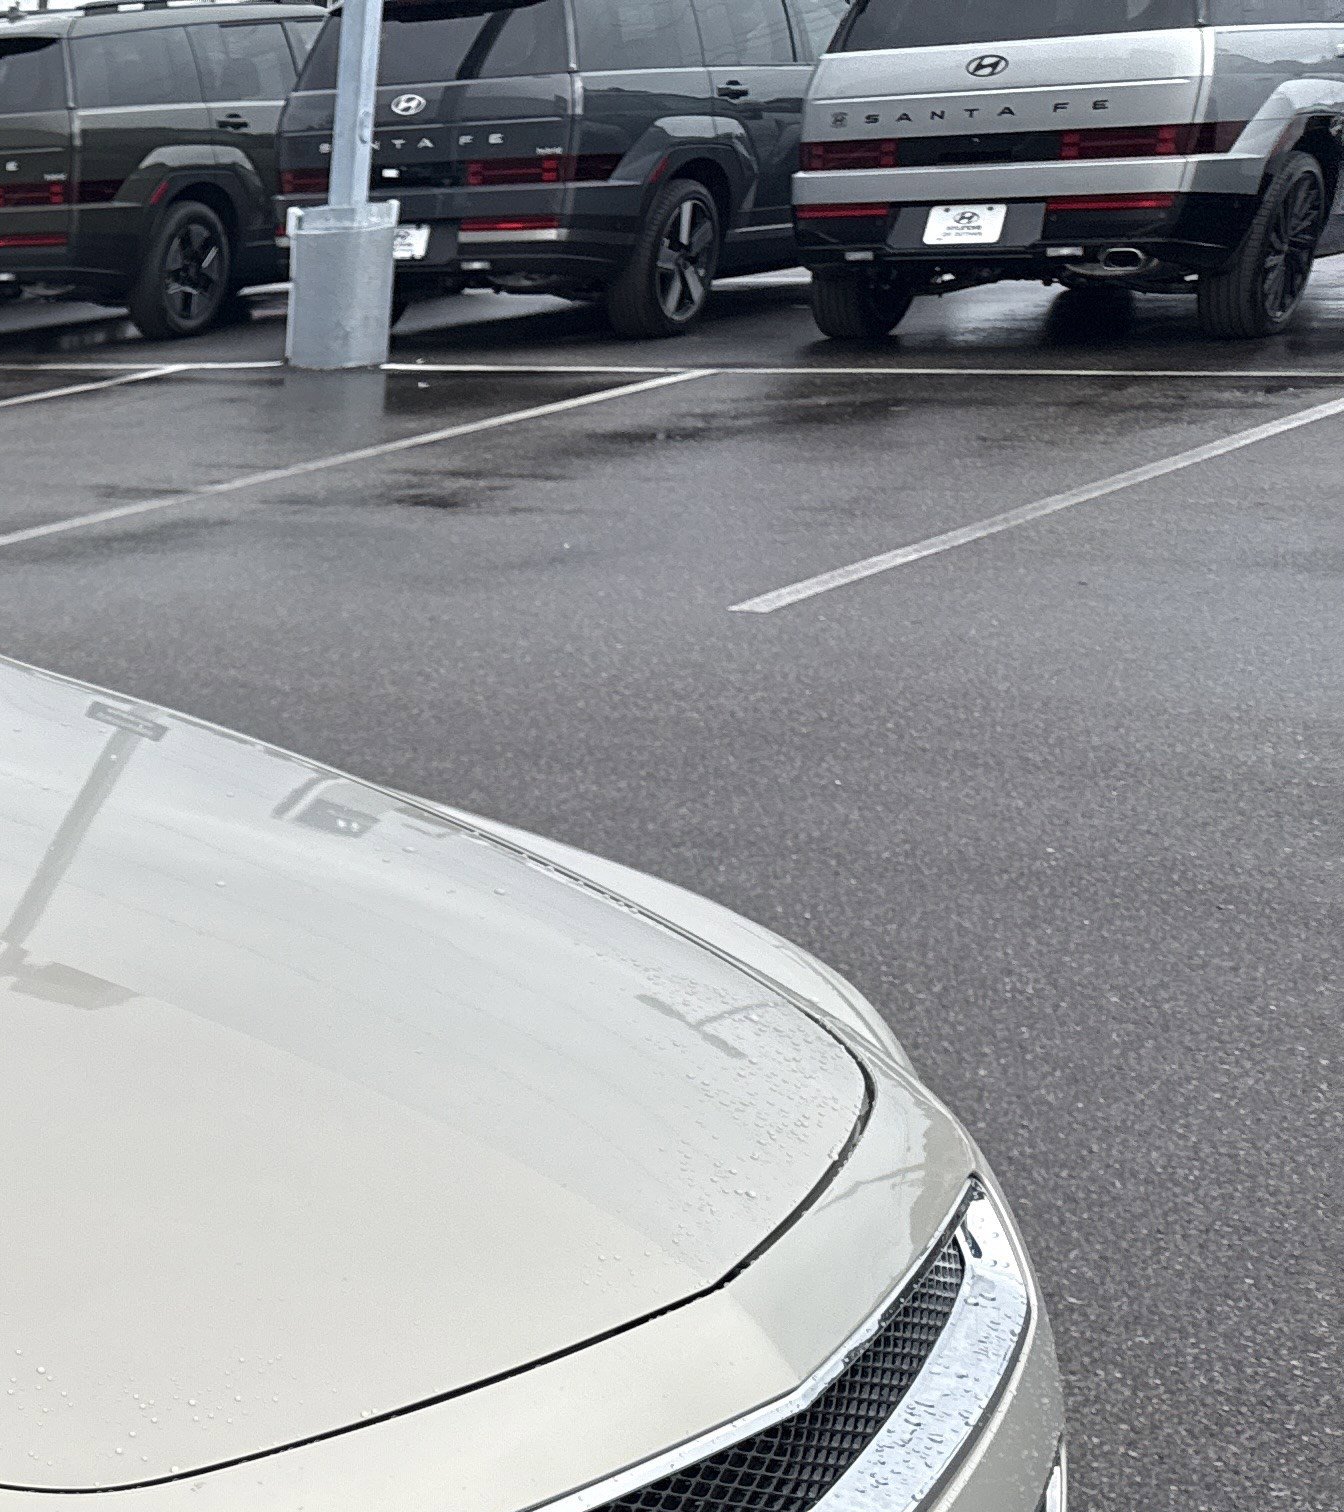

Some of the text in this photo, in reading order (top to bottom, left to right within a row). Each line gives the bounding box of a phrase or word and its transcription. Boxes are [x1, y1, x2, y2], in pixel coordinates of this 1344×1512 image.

[864, 99, 1109, 124] SANTA FE
[319, 132, 504, 155] SNTA FE
